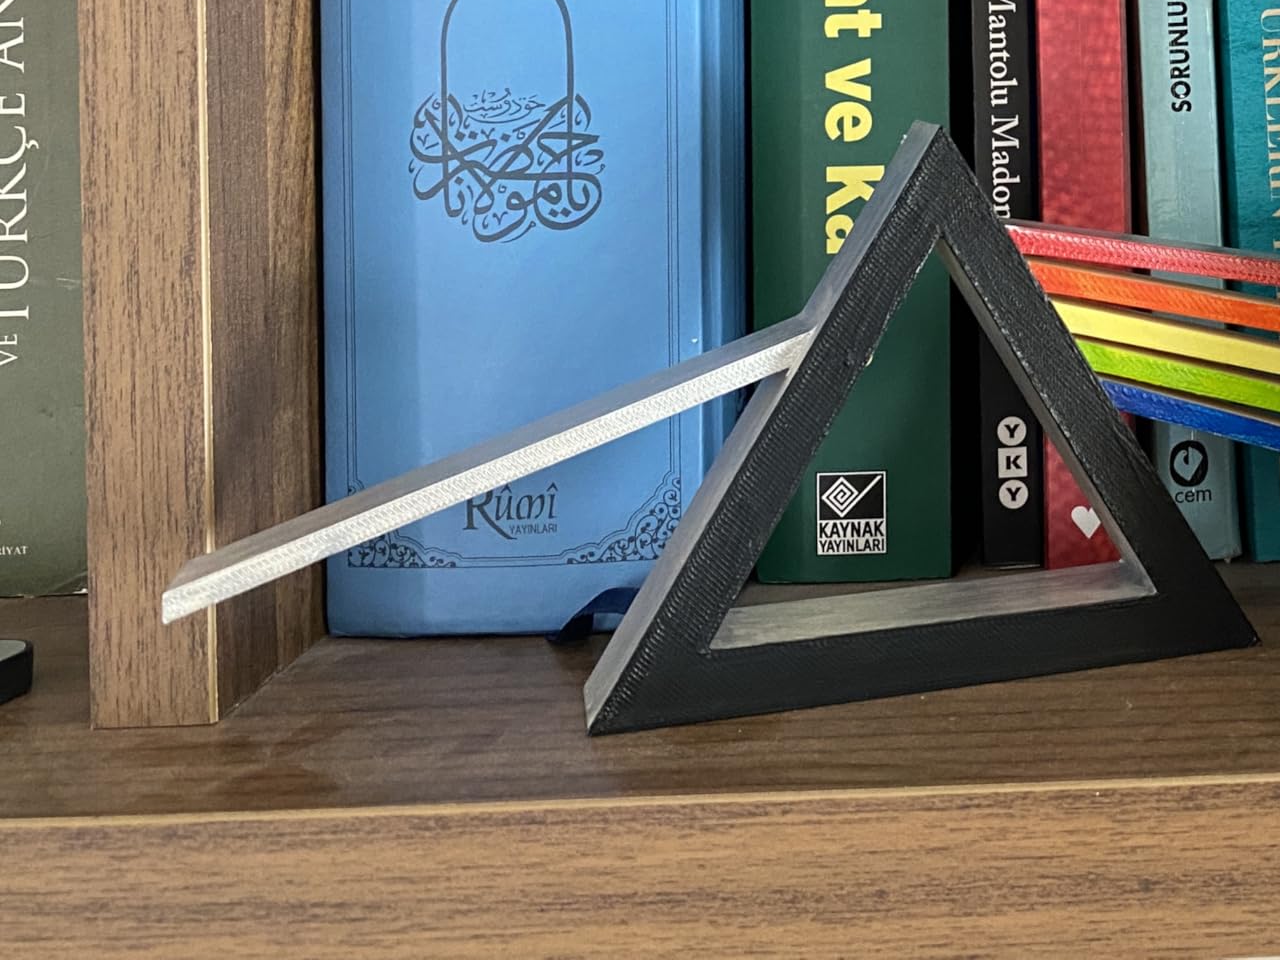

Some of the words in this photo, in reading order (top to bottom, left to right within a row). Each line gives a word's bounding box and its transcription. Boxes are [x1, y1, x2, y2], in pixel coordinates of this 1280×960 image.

[1165, 0, 1193, 113] SORUNLU
[825, 58, 871, 142] ve
[989, 115, 1020, 219] Madon
[824, 165, 885, 255] Ka
[1174, 488, 1213, 505] cem
[509, 524, 558, 536] YAYINLARI
[818, 520, 885, 539] KAYNAK
[818, 538, 885, 553] YAYINLARI
